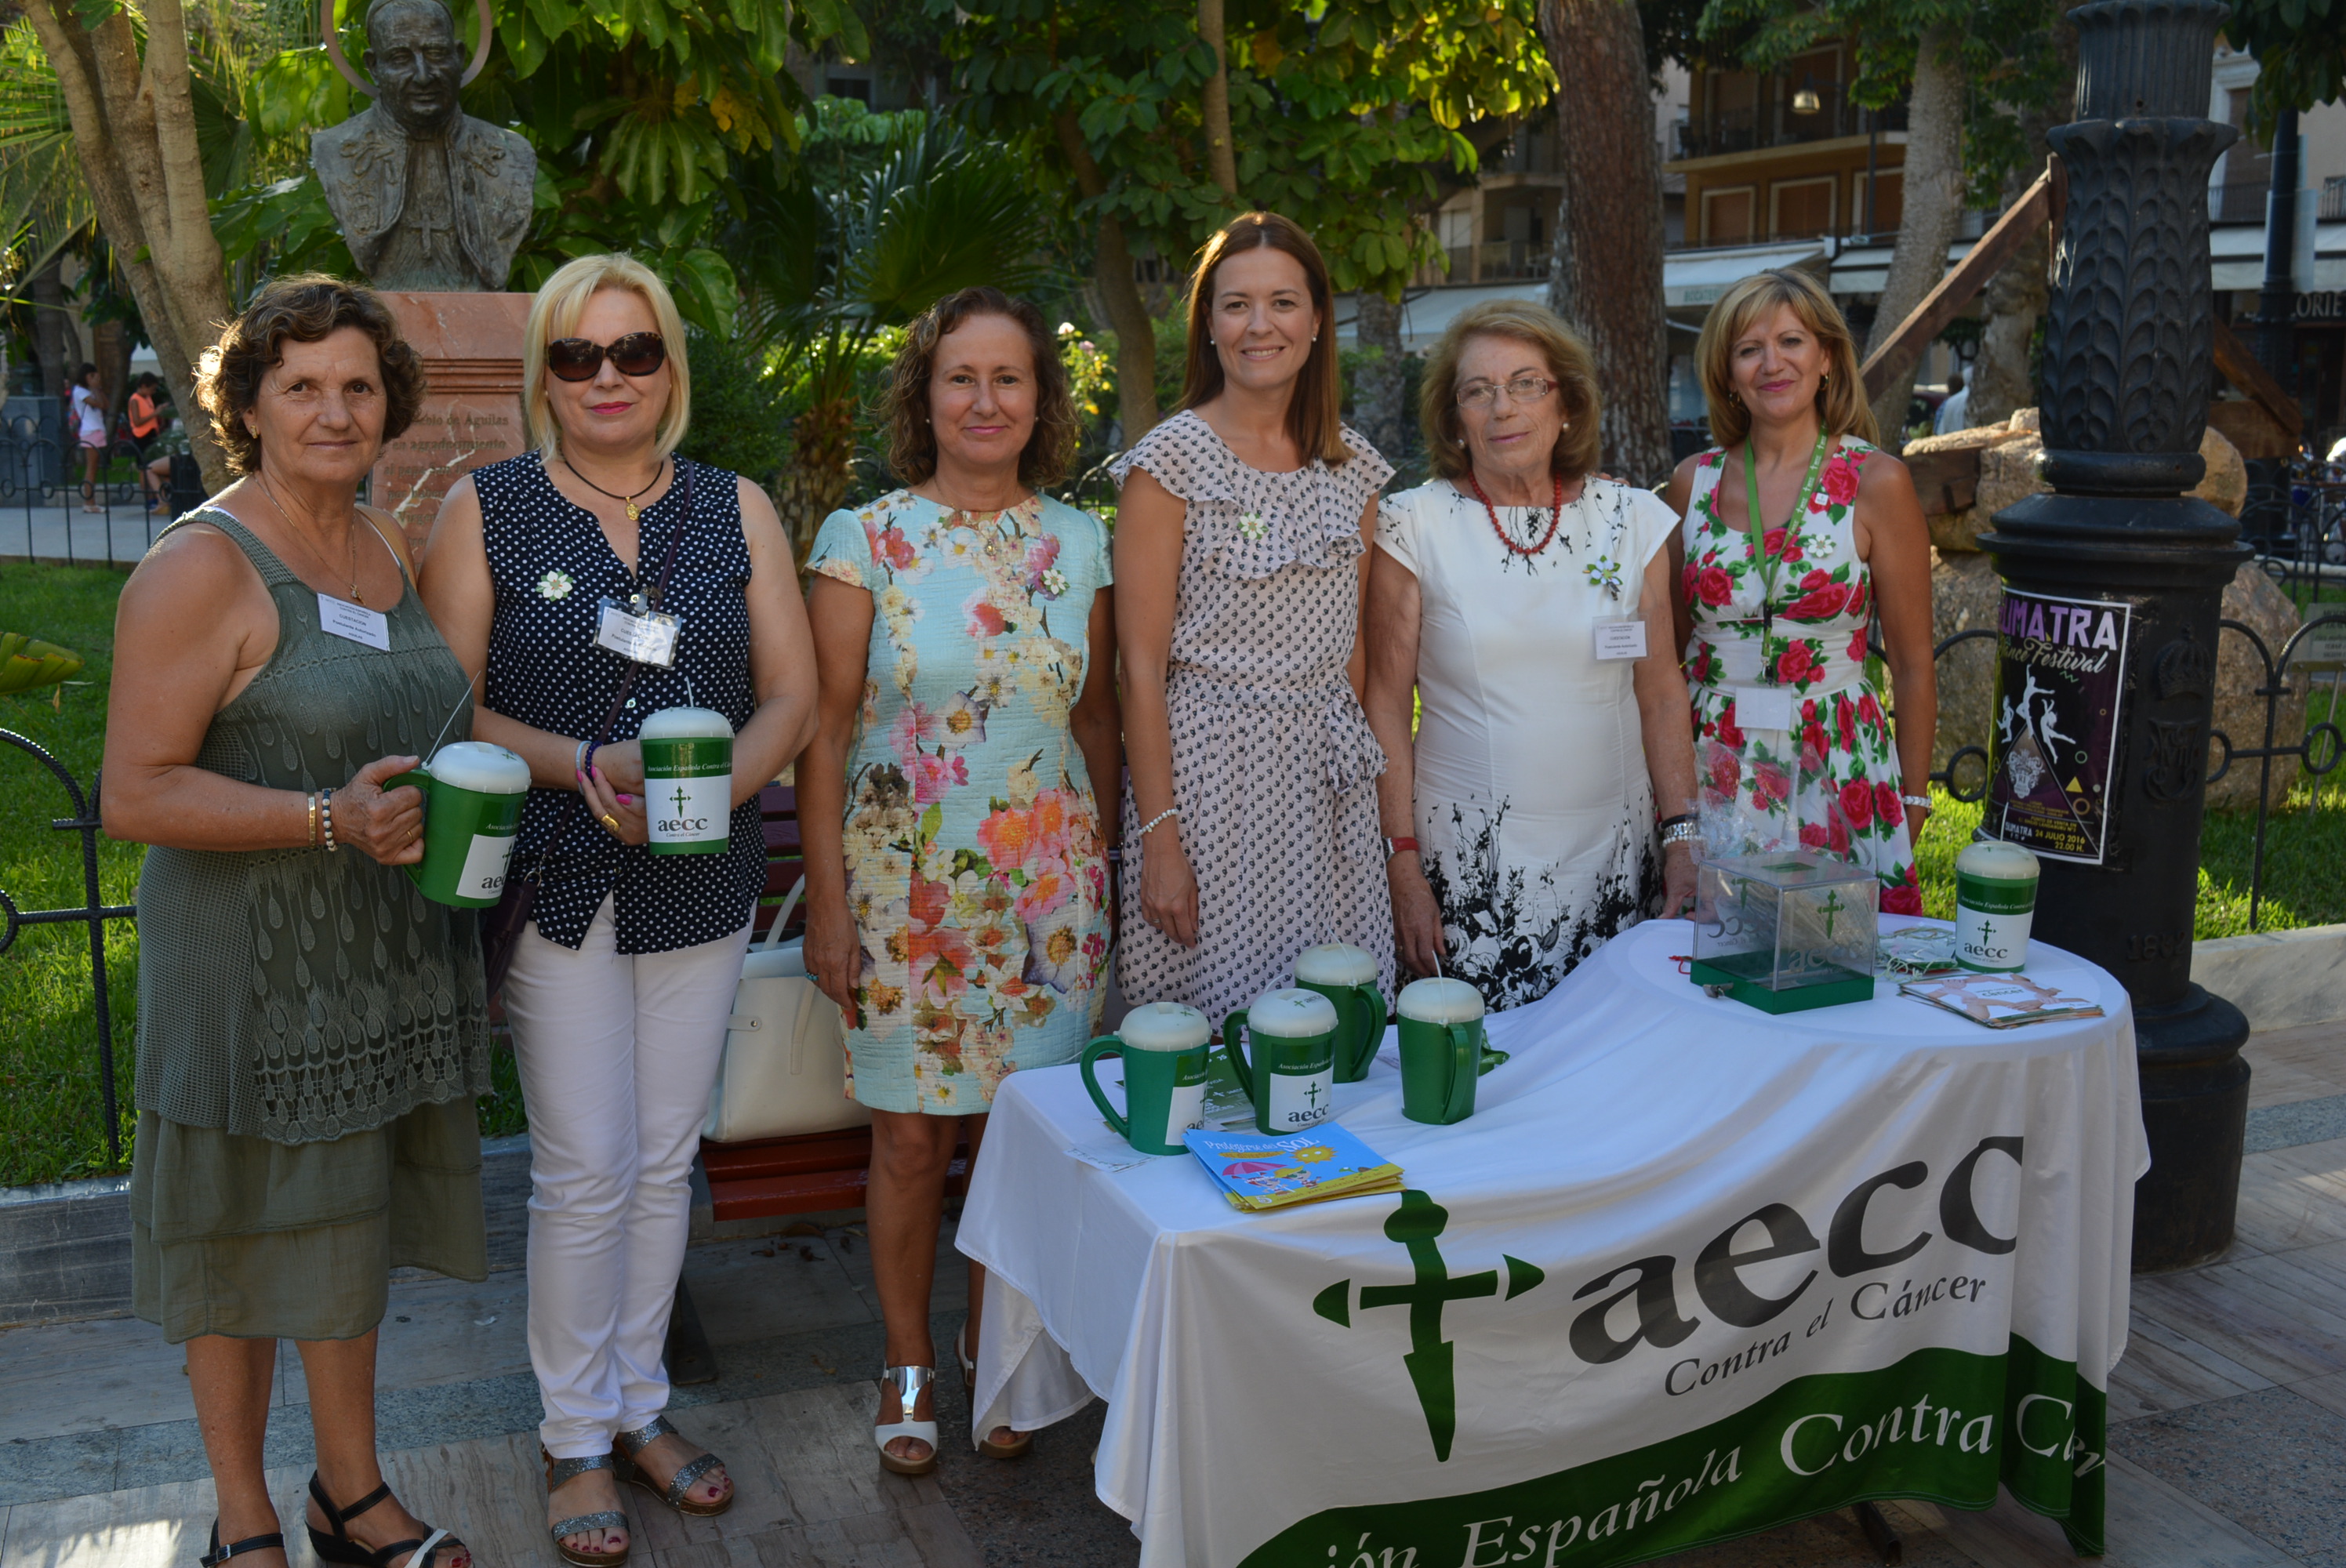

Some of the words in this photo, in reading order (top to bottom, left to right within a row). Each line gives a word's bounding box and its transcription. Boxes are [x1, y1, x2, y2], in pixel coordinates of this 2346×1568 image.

[2024, 637, 2109, 674] Festival
[658, 818, 708, 832] aecc
[2005, 822, 2032, 837] SUMATRA
[2044, 831, 2066, 841] JULIO
[2067, 835, 2086, 844] 2016
[2054, 841, 2075, 851] 22.00
[1964, 942, 2008, 959] aecc
[1288, 1103, 1329, 1123] aecc
[1204, 1141, 1263, 1153] Protegerse
[1276, 1137, 1320, 1152] SOL
[1569, 1135, 2024, 1365] aecc
[1665, 1331, 1792, 1396] Contra
[1807, 1297, 1833, 1338] el
[1850, 1276, 1986, 1320] Cáncer
[1458, 1446, 1743, 1568] Española
[1780, 1393, 1994, 1476] Contra
